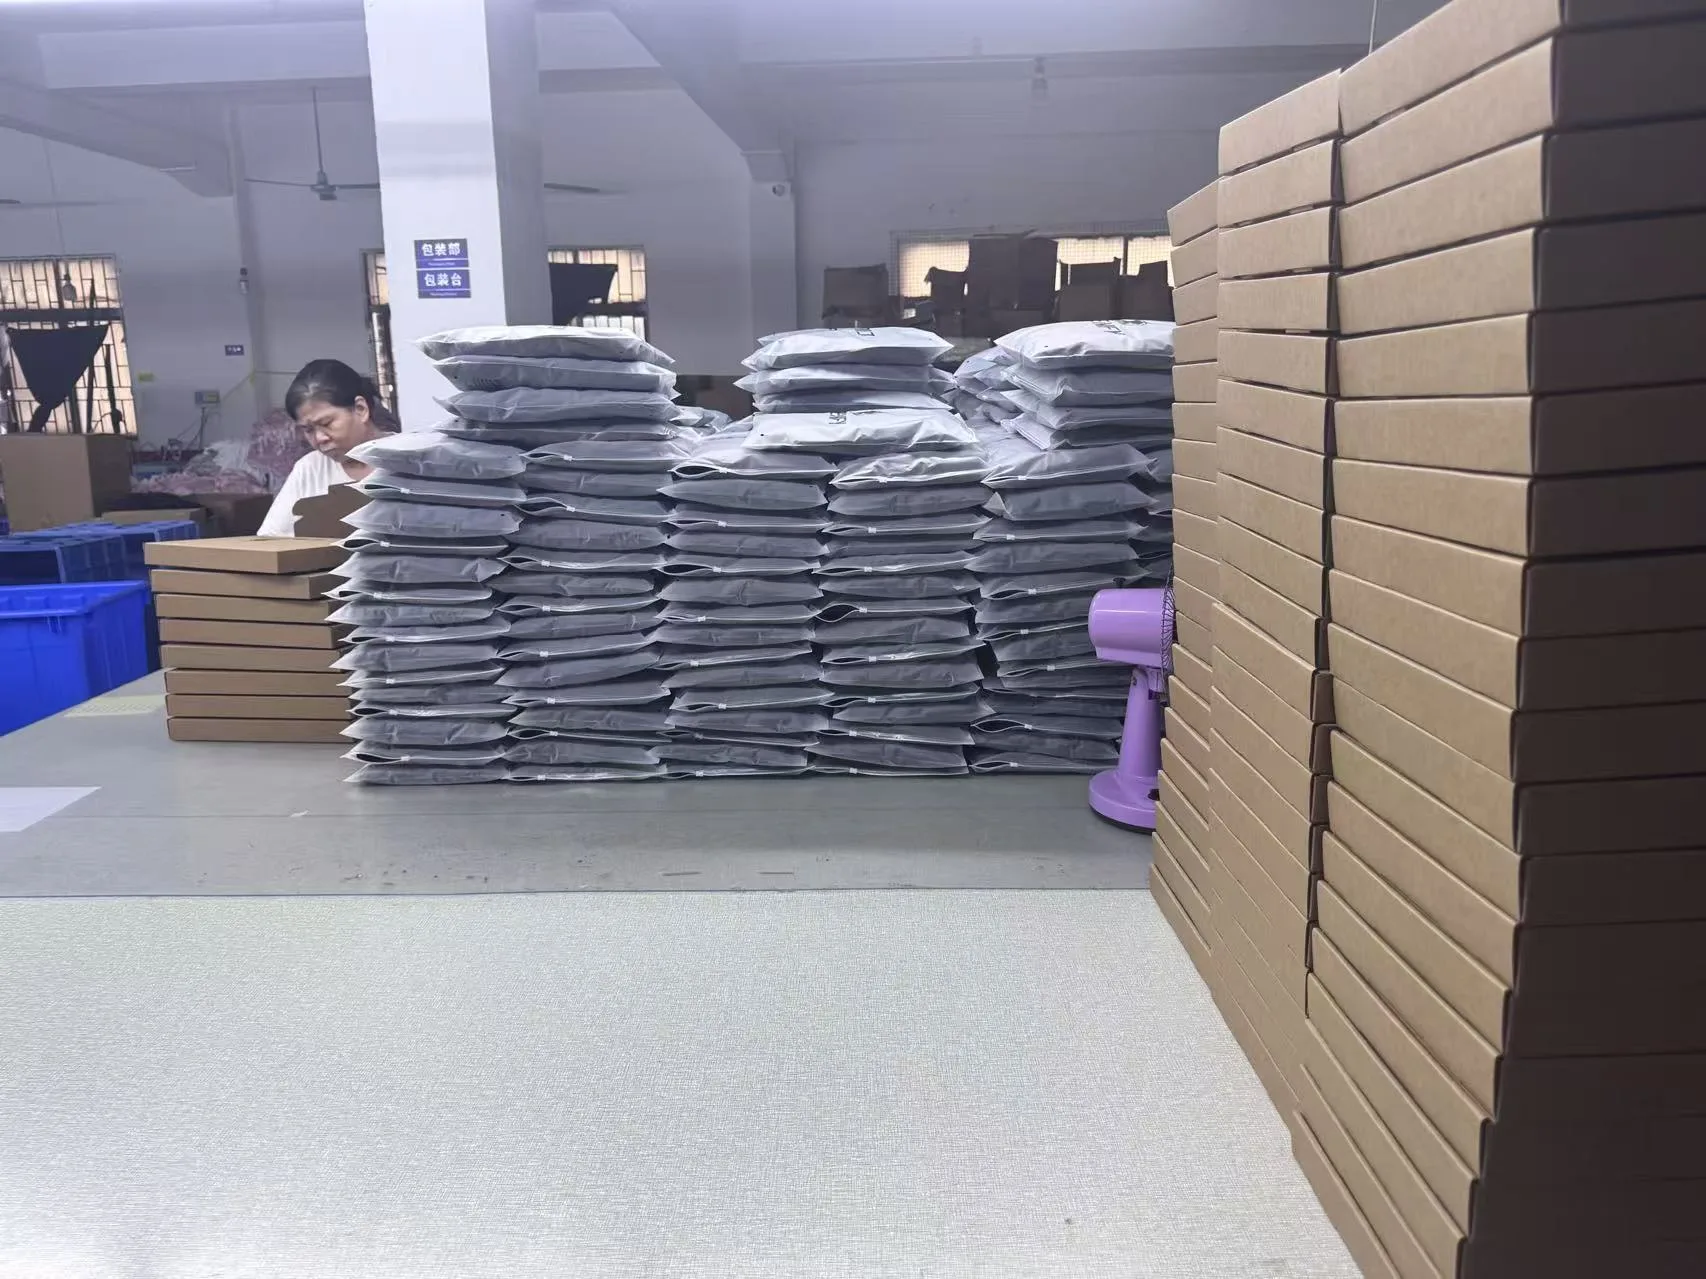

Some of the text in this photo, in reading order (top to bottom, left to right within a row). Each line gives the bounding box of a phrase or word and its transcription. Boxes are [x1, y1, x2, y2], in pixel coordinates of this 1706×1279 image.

[422, 242, 460, 256] 包装部
[424, 272, 462, 287] 包装台
